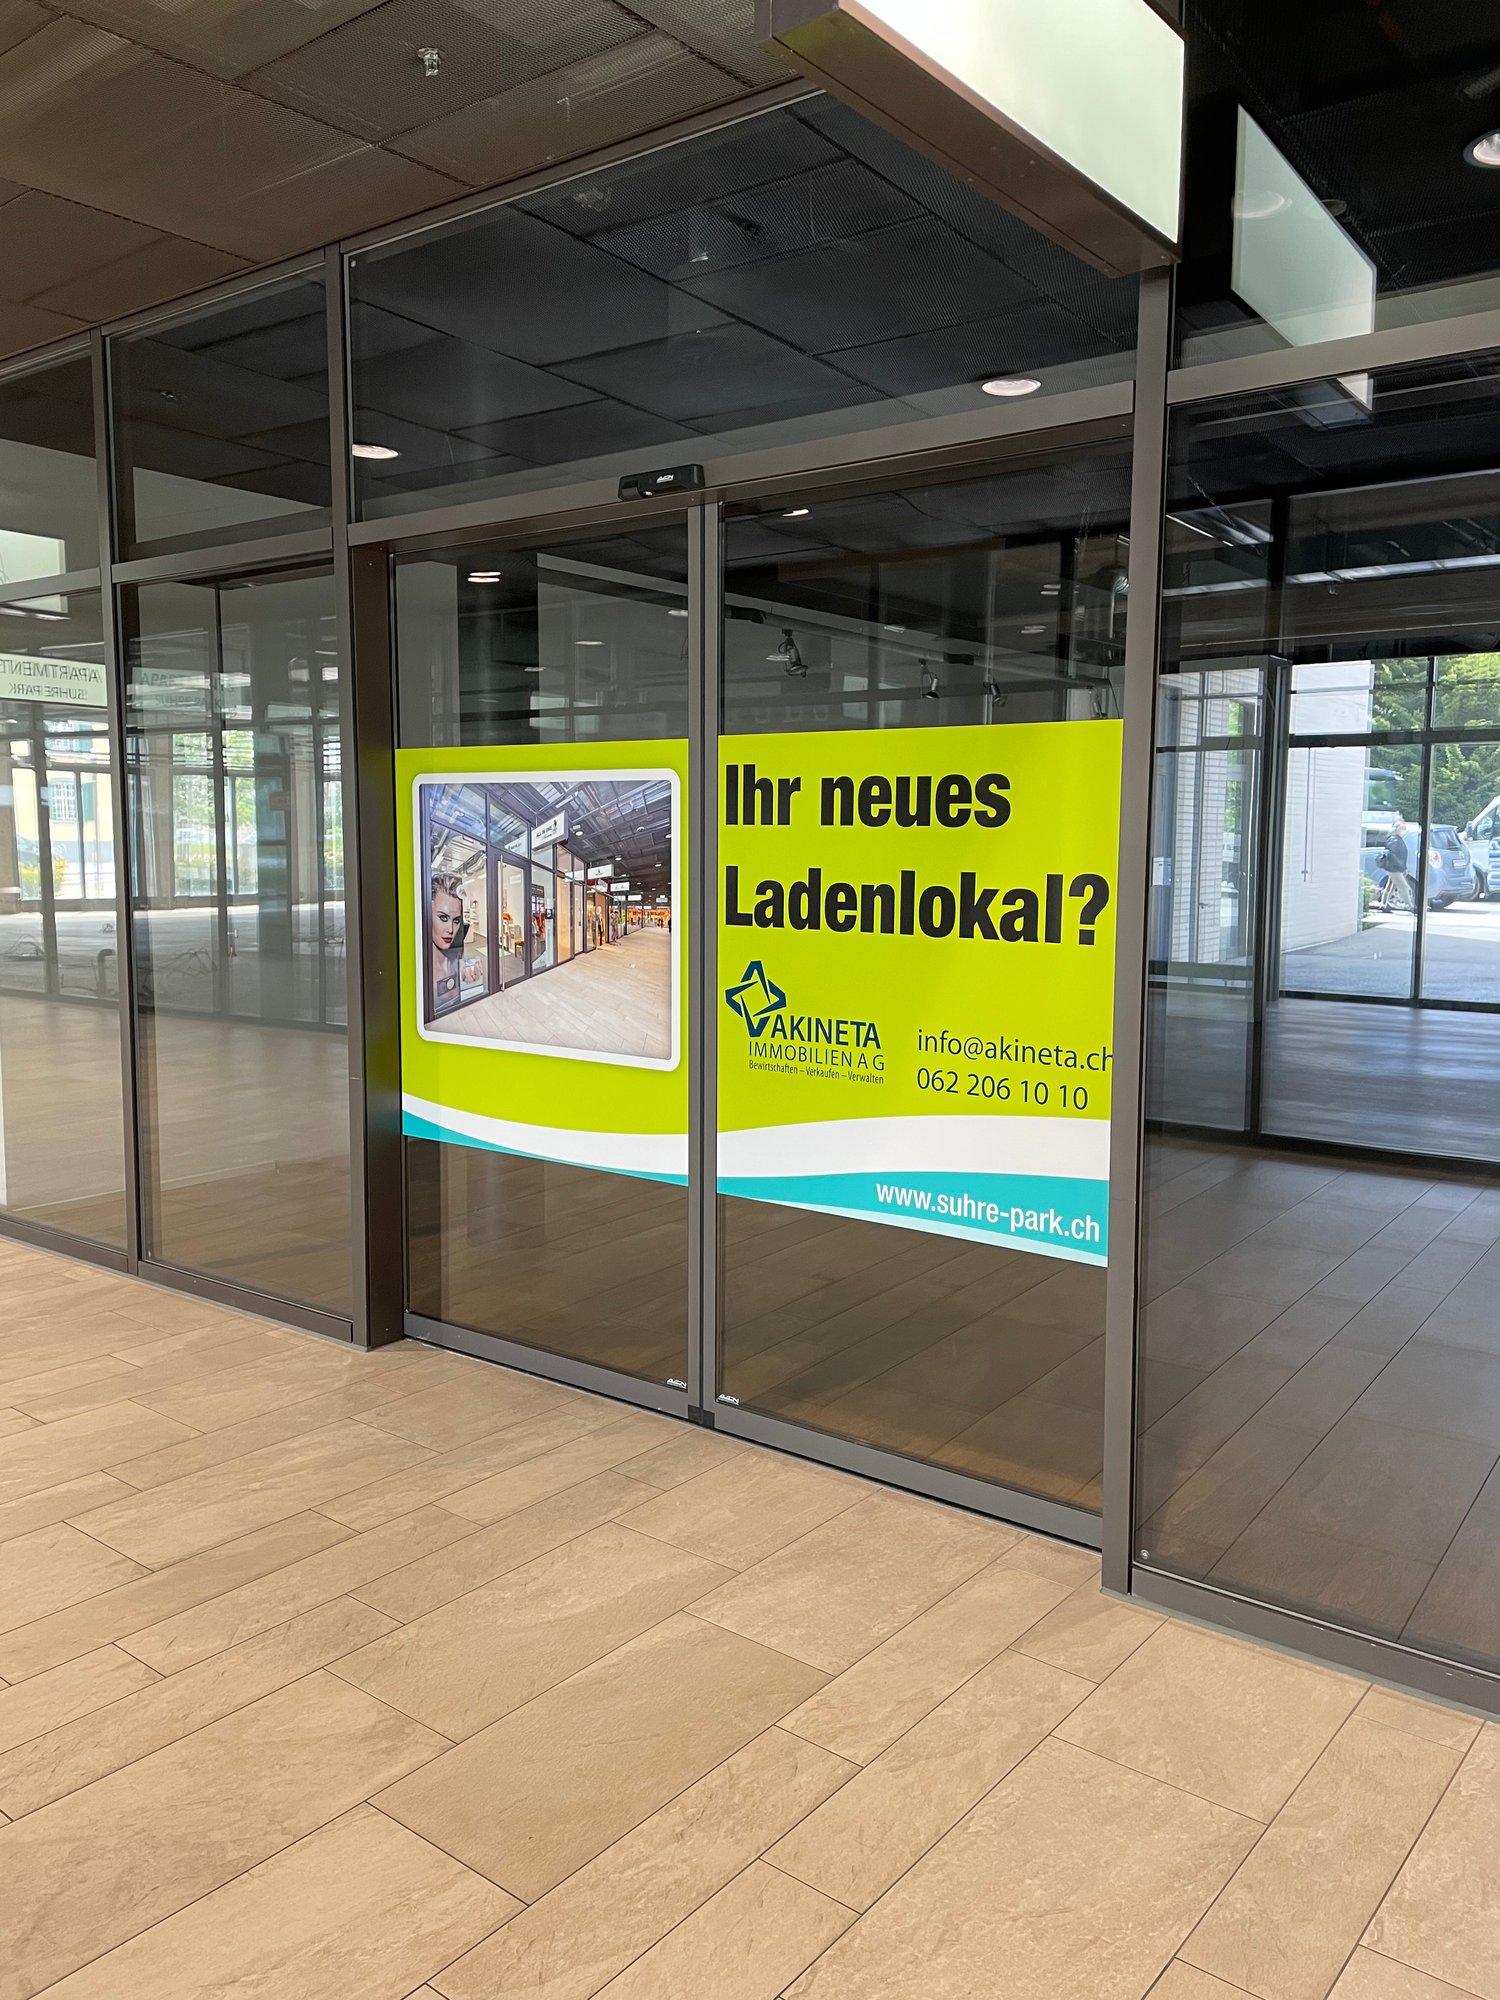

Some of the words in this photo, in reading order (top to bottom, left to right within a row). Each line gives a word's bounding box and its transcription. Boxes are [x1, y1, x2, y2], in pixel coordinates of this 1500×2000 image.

[725, 764, 801, 826] Ihr
[820, 773, 1011, 828] neues
[725, 865, 1110, 946] Ladenlokal?
[770, 1013, 882, 1049] AKINETA
[917, 1028, 1113, 1072] info@akineta.ch
[749, 1041, 852, 1067] IMMOBILIEN
[749, 1060, 798, 1074] Bewirtschaften
[805, 1066, 840, 1079] Verkaufen
[847, 1071, 884, 1084] Verwalten
[917, 1067, 959, 1094] 062
[966, 1073, 1011, 1100] 206
[1020, 1080, 1049, 1105] 10
[1059, 1085, 1089, 1110] 10
[876, 1183, 1101, 1243] www.suhre-park.ch
